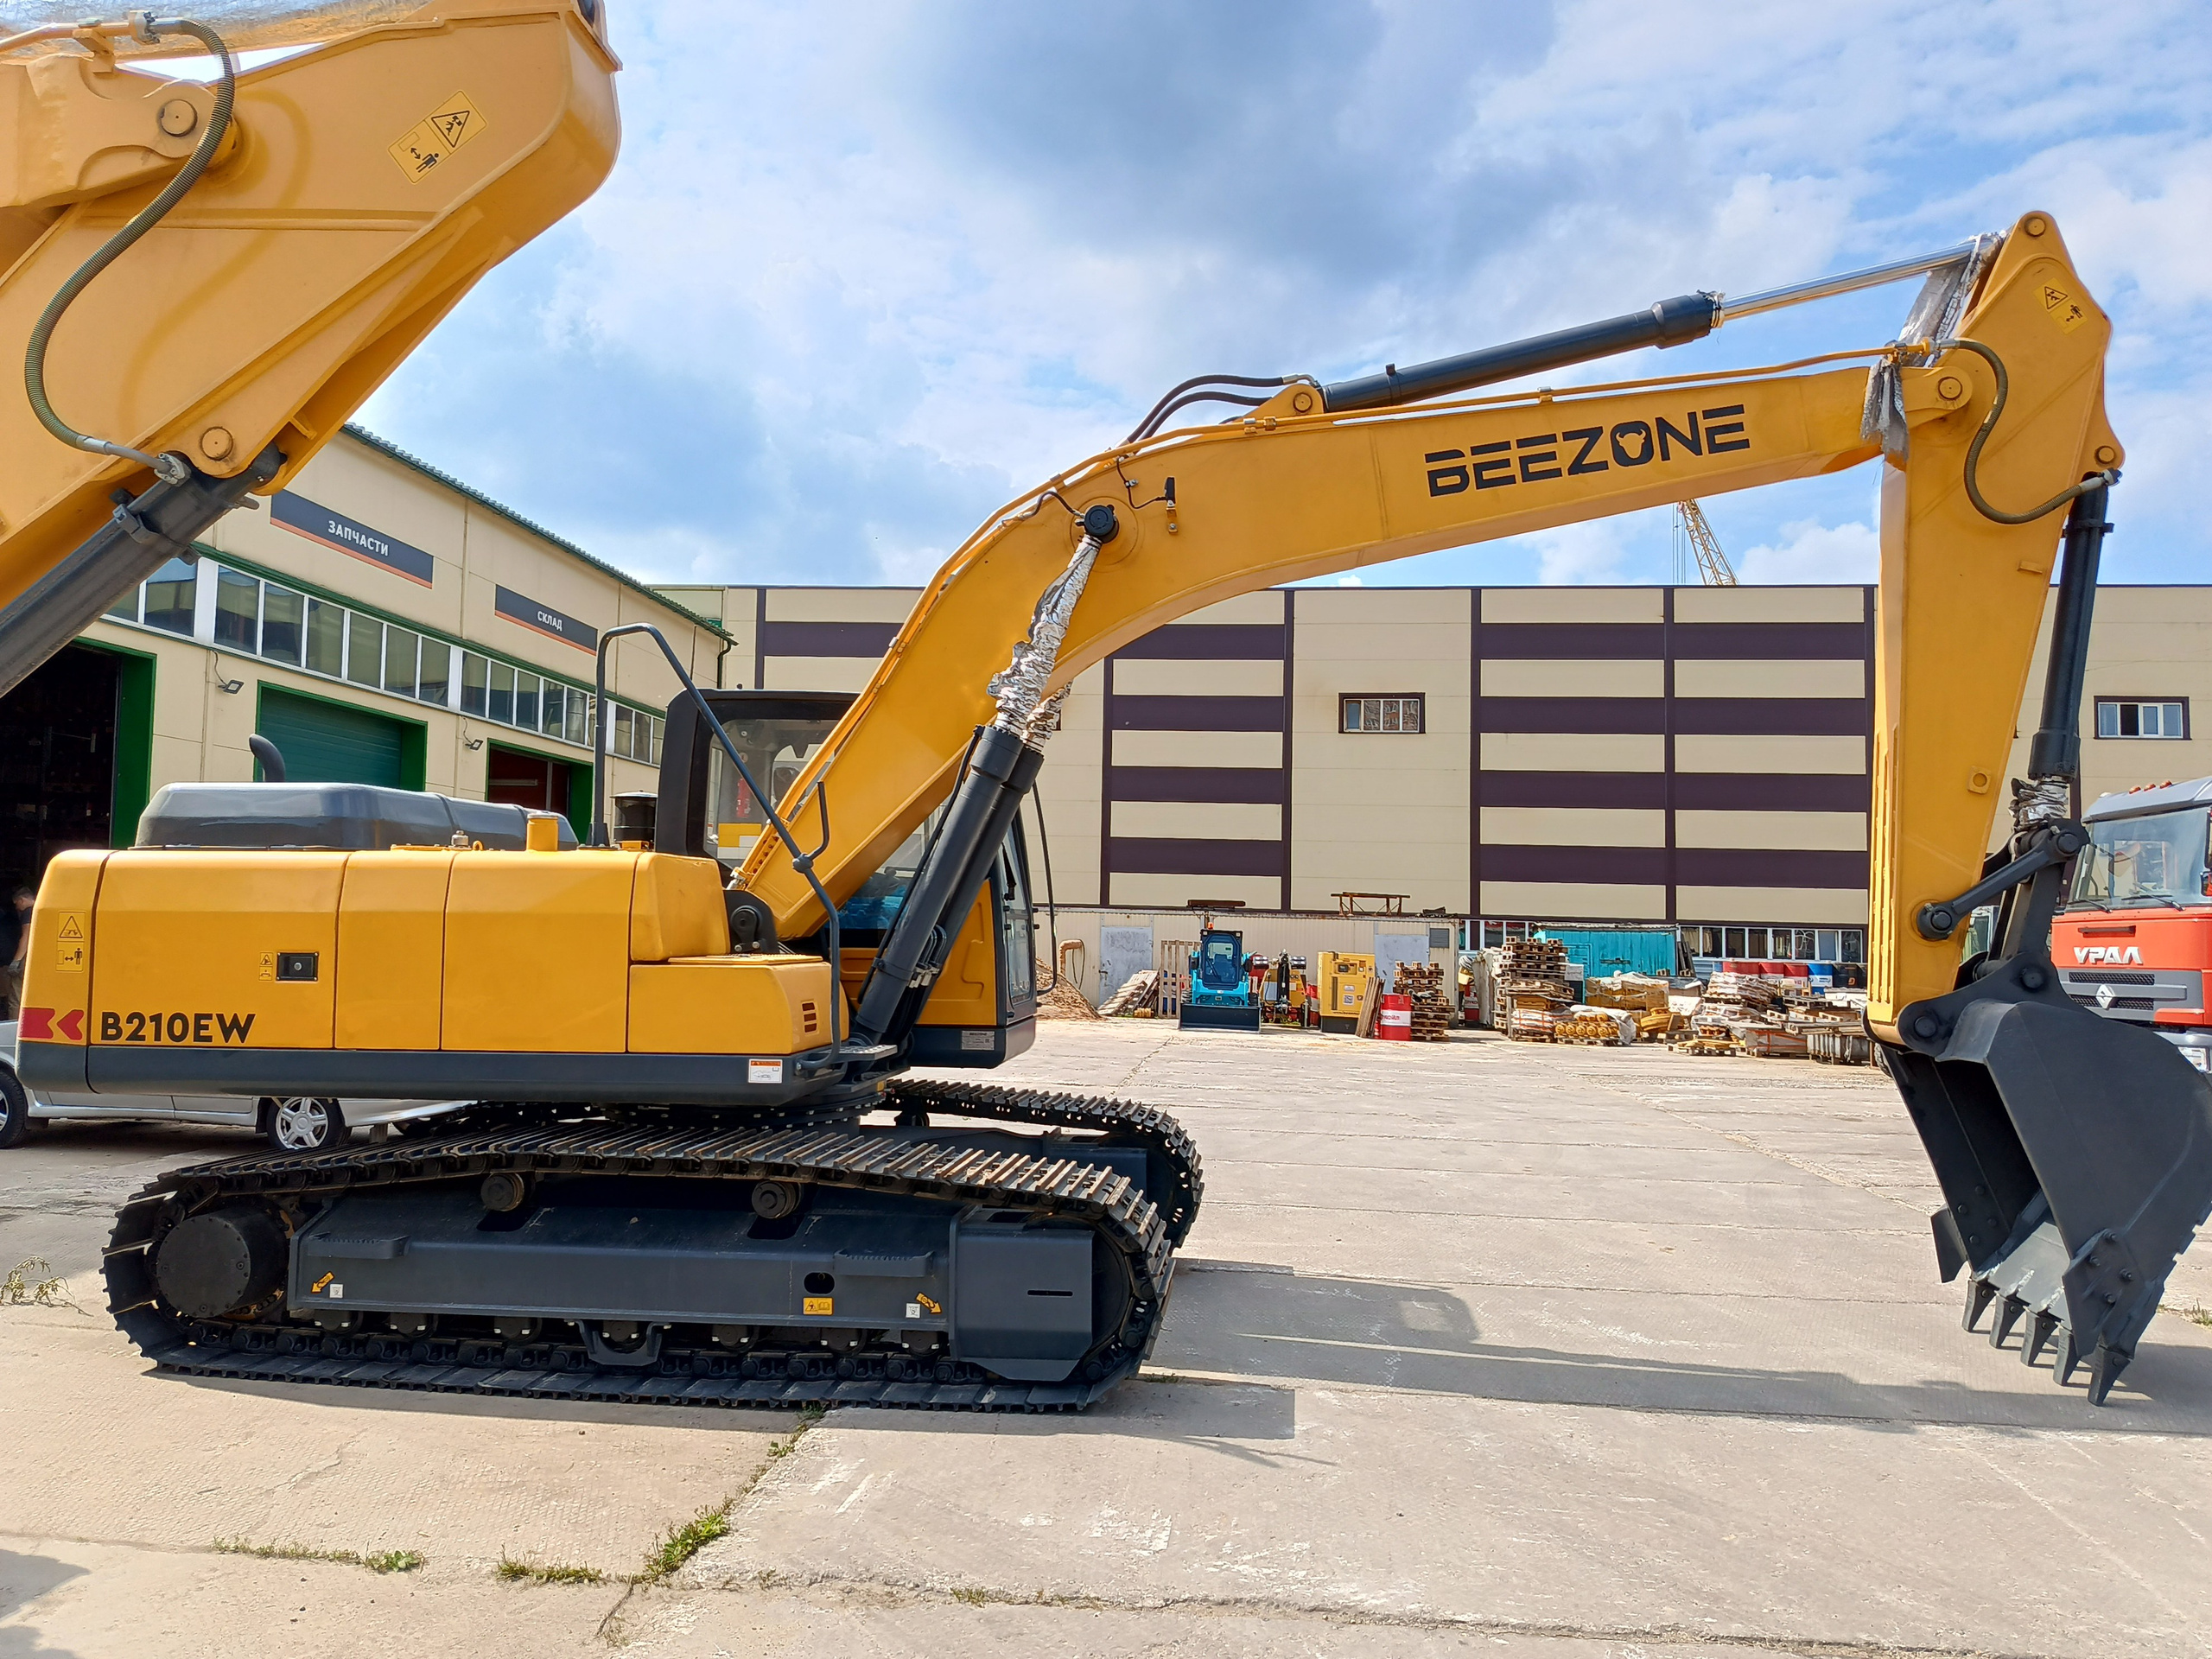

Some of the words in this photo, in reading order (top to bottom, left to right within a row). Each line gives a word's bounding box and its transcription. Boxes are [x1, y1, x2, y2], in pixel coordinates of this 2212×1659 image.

[1424, 404, 1751, 498] BEEZONE
[327, 520, 389, 556] ЗАПЧАСТИ
[537, 610, 563, 632] СКЛАД
[2073, 946, 2143, 965] УРАЛ
[100, 1011, 257, 1044] B210EW
